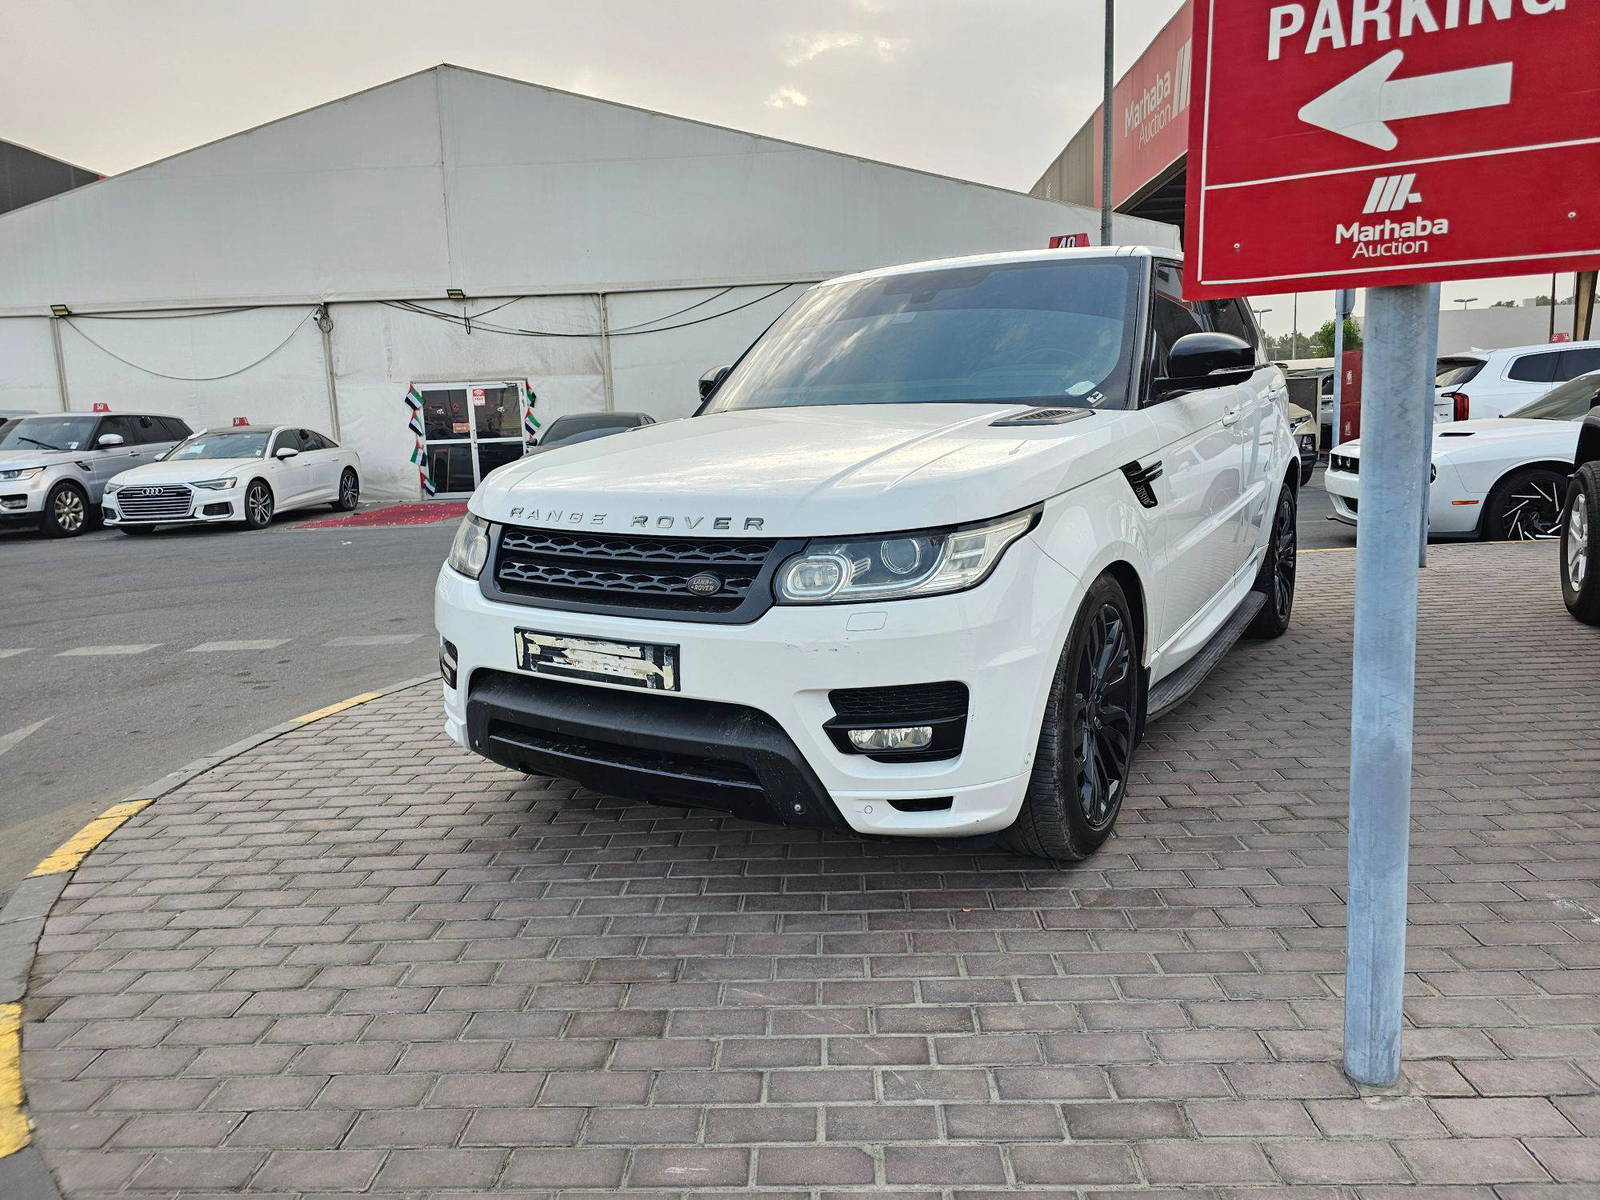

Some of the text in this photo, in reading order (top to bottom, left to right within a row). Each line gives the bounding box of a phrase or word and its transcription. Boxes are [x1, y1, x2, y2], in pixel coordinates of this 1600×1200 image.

[1267, 0, 1566, 61] PARKI
[1124, 70, 1171, 137] Marhaba
[1138, 103, 1171, 149] Auction
[1335, 216, 1449, 244] Marhaba
[1351, 238, 1428, 259] Auction
[510, 506, 765, 532] RANGE ROVER
